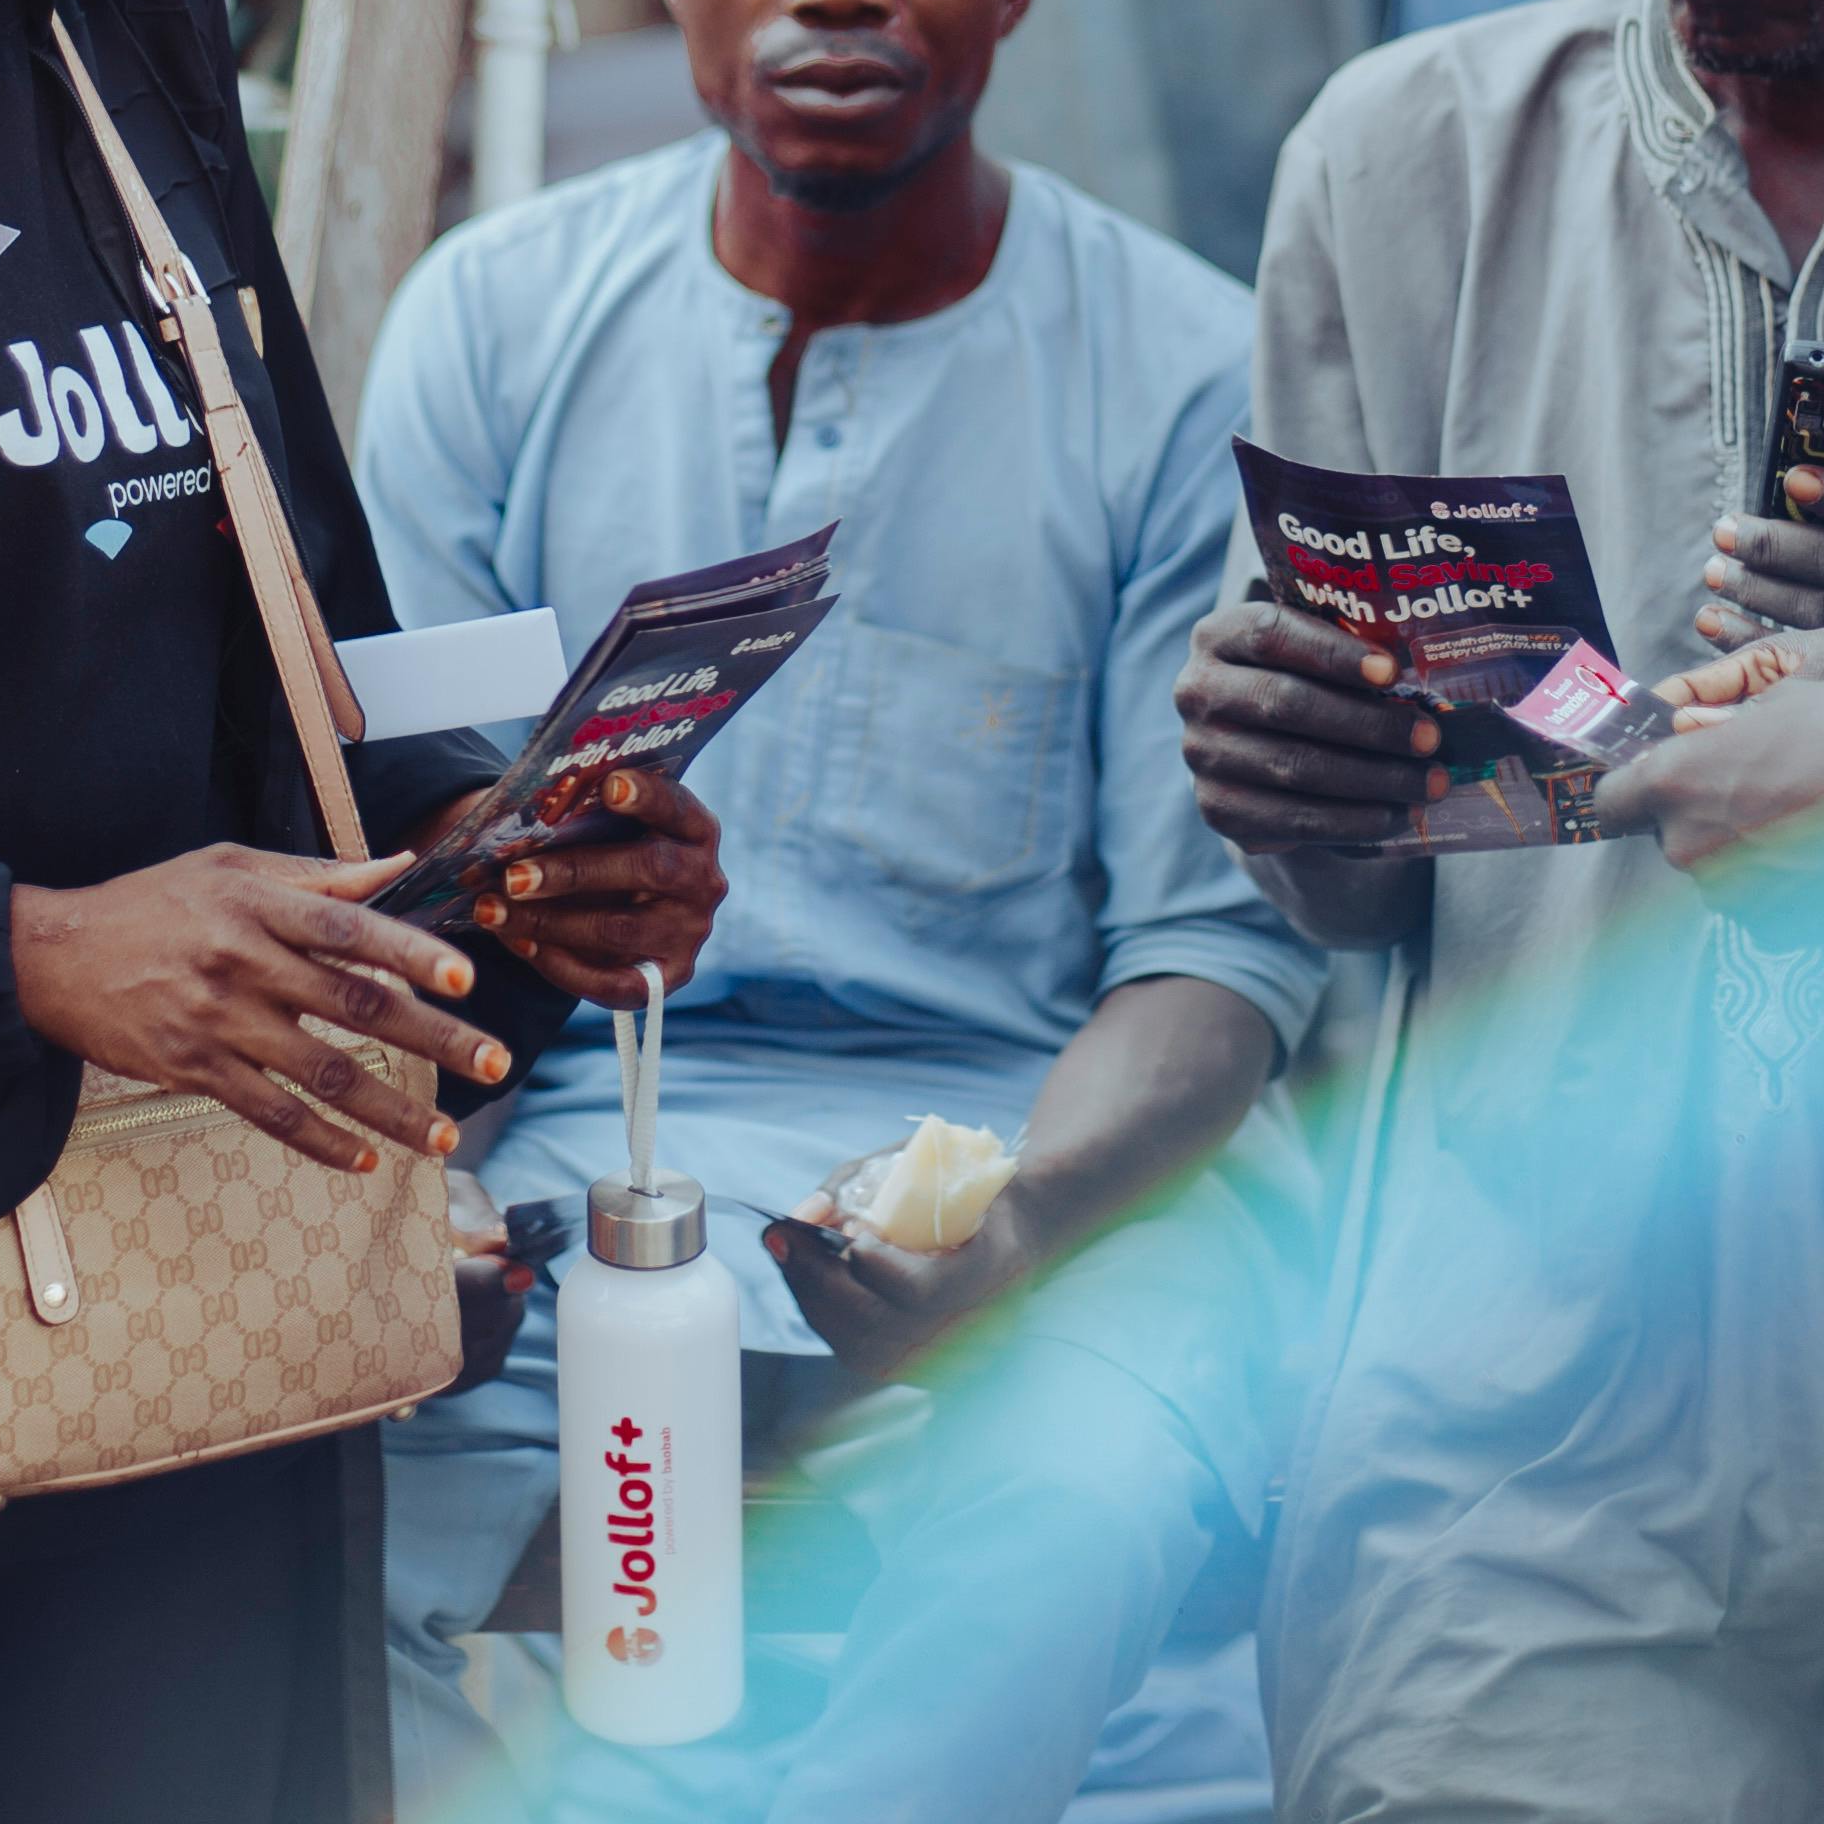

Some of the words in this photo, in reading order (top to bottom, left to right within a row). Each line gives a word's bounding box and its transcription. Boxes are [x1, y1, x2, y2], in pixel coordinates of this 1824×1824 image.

[107, 460, 212, 518] powered
[1453, 502, 1538, 520] Jollof+
[1278, 512, 1373, 560] Good
[1379, 525, 1476, 560] Life,
[1286, 545, 1381, 592] Good
[1388, 556, 1554, 591] Savings
[1295, 578, 1376, 623] with
[1384, 584, 1533, 623] Jollof+
[1423, 639, 1452, 654] Start
[1492, 632, 1514, 642] low
[1437, 646, 1472, 660] enjoy
[1472, 644, 1488, 656] up
[597, 674, 669, 712] Good
[663, 666, 720, 697] Life,
[546, 738, 610, 776] with
[606, 718, 697, 761] Jollof+
[571, 703, 651, 745] Good
[661, 1426, 673, 1474] baobab
[605, 1417, 657, 1616] Jollof+
